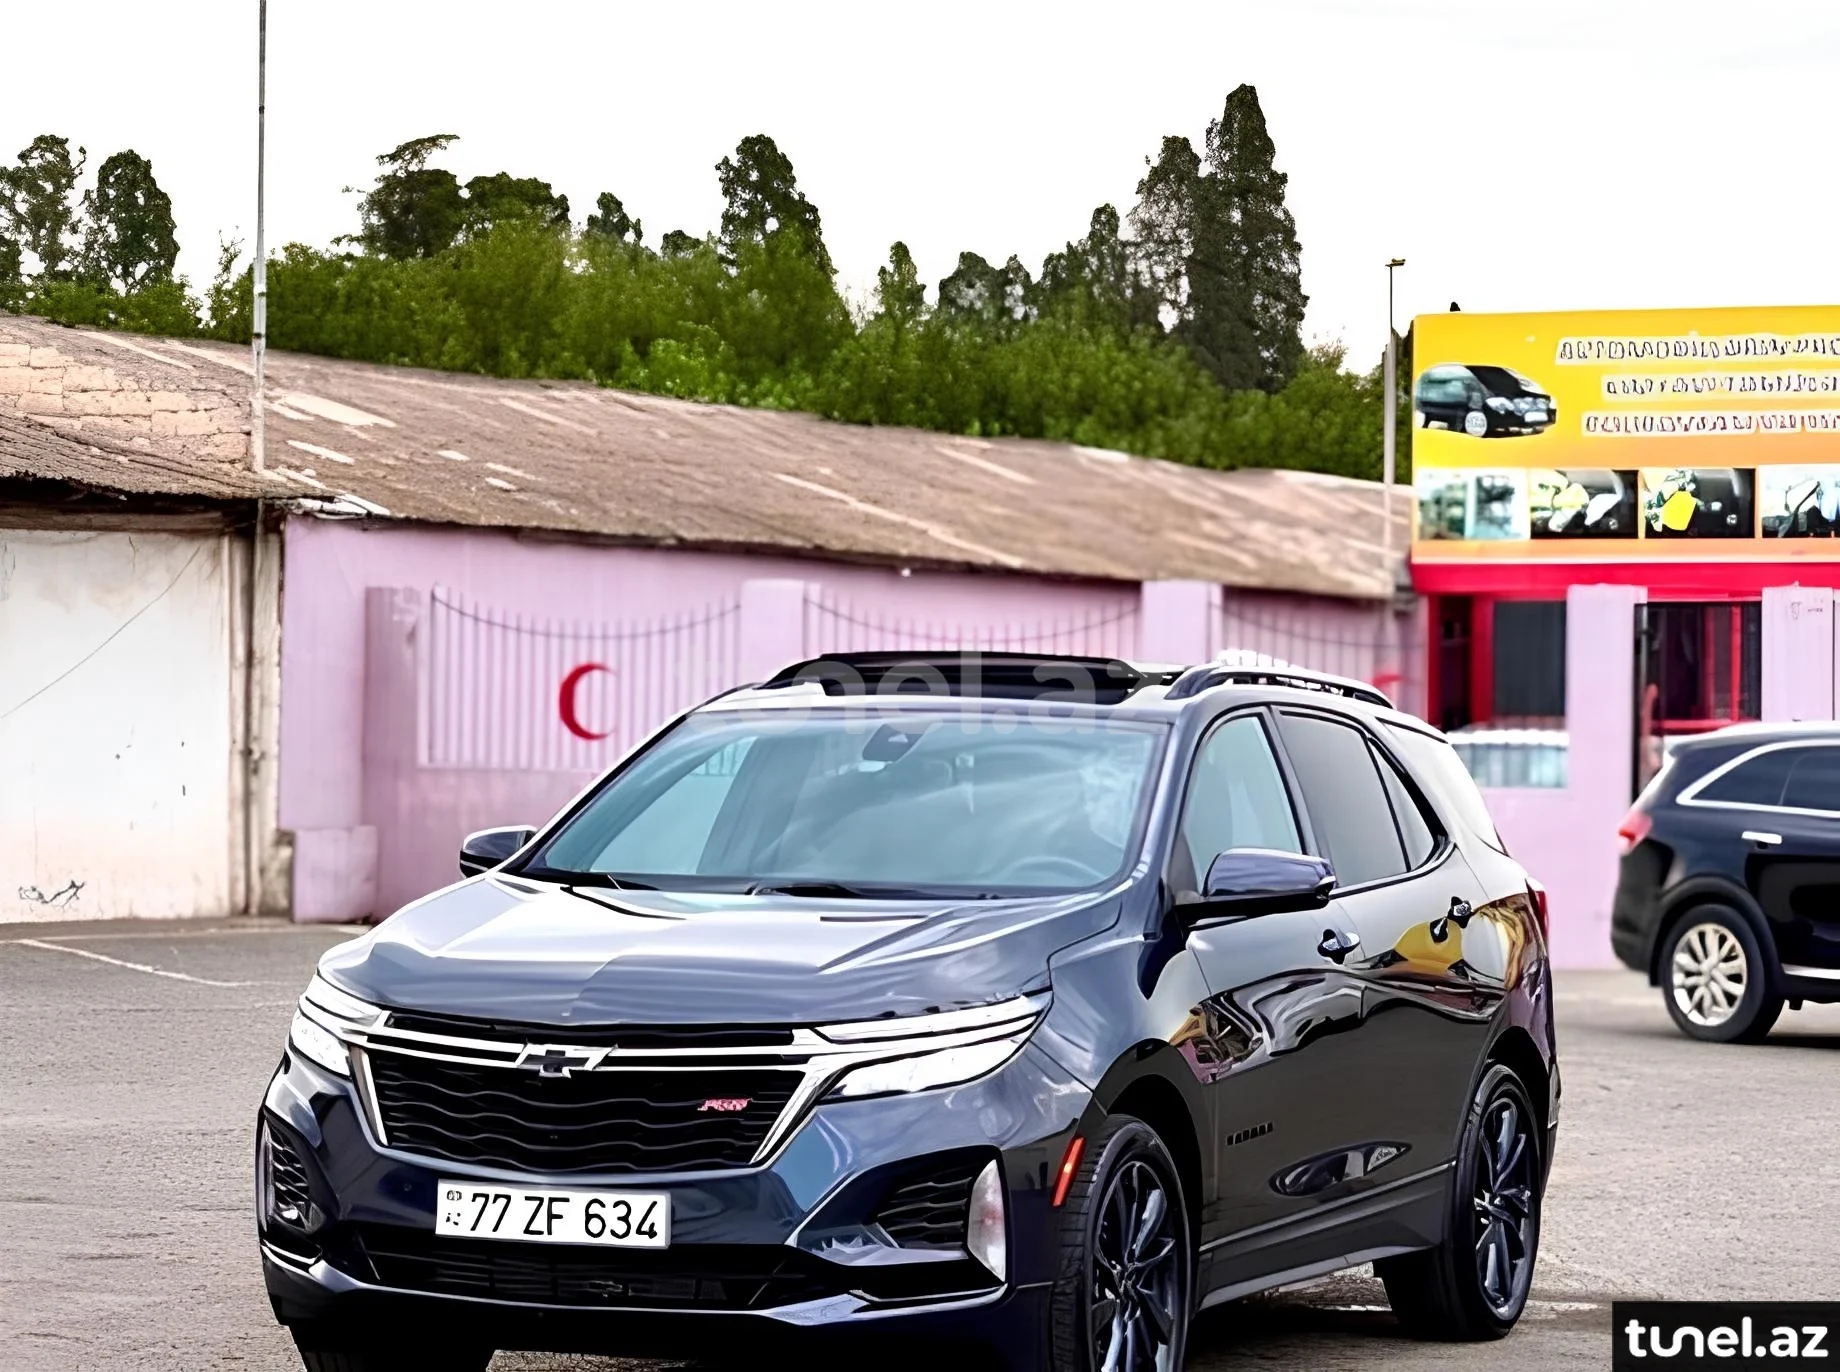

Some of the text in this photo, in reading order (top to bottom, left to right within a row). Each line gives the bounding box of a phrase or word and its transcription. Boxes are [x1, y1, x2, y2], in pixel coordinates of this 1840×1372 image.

[470, 1192, 658, 1239] 77 ZF 634
